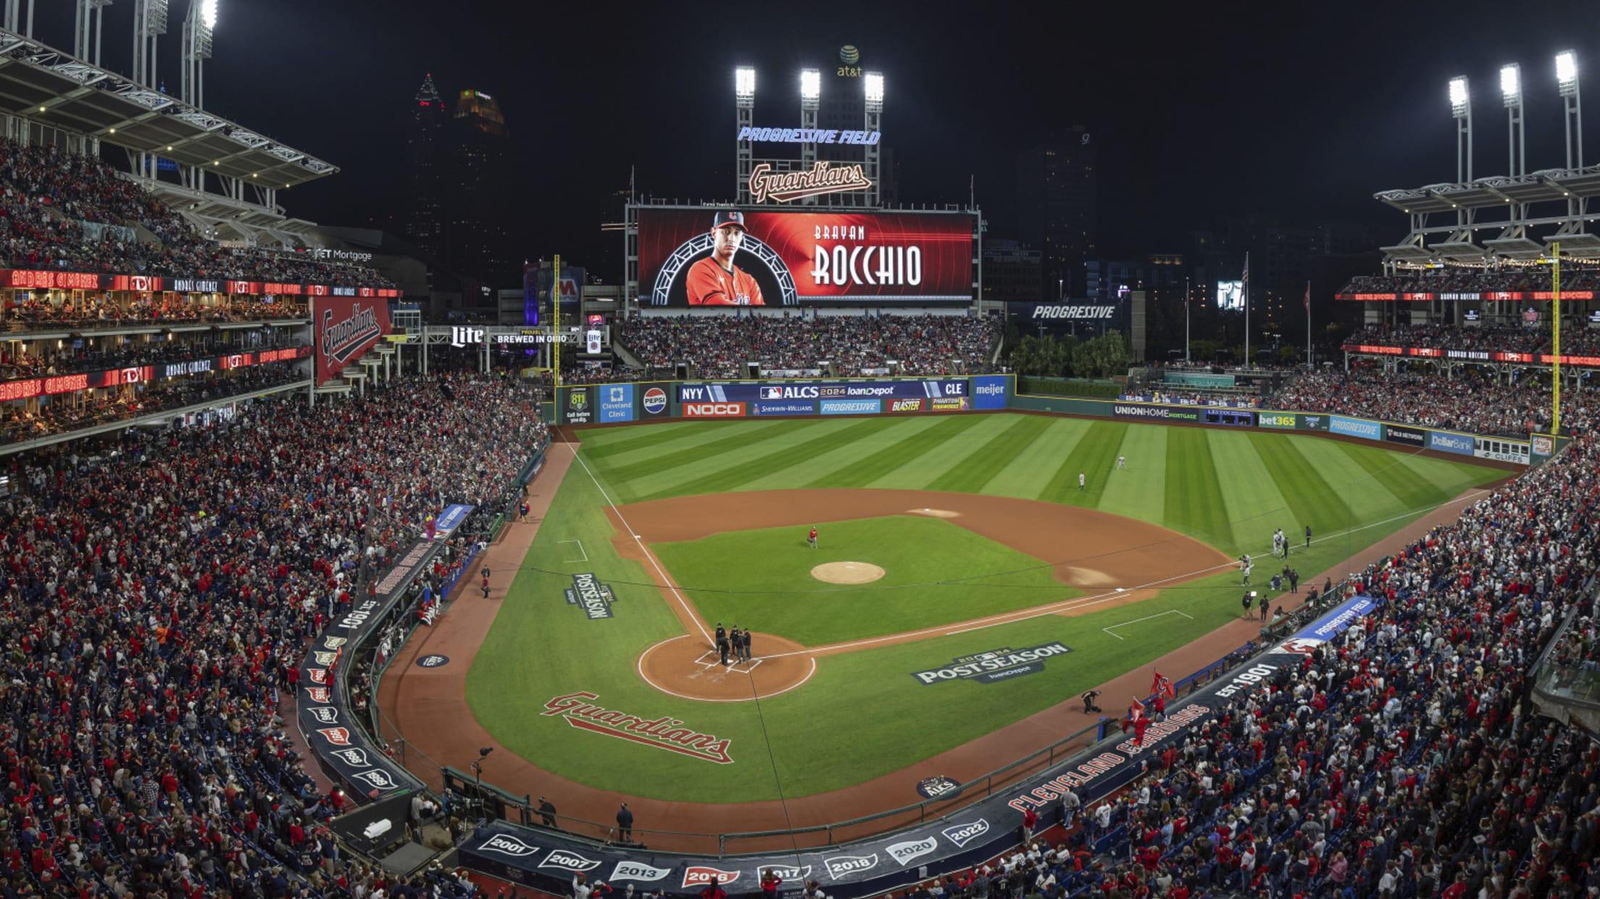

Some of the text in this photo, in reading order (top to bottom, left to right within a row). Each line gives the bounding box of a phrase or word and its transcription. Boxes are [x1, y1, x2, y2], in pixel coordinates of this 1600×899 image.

[837, 66, 862, 78] at&t
[738, 127, 881, 145] PROGRESSIVE FIELD
[749, 161, 872, 203] Guardians
[814, 225, 865, 240] BRAYAN
[333, 250, 372, 262] Mortgage
[810, 245, 922, 286] ROCCHIO
[1032, 305, 1115, 319] PROGRESSIVE
[323, 303, 380, 367] Guardians
[451, 326, 484, 348] Lite
[682, 388, 703, 400] NYY
[783, 386, 819, 398] ALCS
[847, 386, 894, 396] loanDepot
[945, 383, 962, 395] CLE
[976, 385, 1004, 396] meijer
[571, 393, 586, 405] 811
[644, 396, 666, 404] PEPSI
[892, 400, 920, 411] BLASTER
[687, 404, 740, 415] NOCO
[822, 402, 876, 411] PROGRESSIVE
[1259, 413, 1296, 426] bet365
[1331, 418, 1378, 436] PROGRESSIVE
[1495, 453, 1523, 464] CLIFFS
[575, 573, 608, 619] POSTSEASON
[917, 643, 1069, 684] POSTSEASON
[1236, 663, 1279, 686] 1901
[540, 691, 734, 764] Guardians
[1008, 752, 1125, 813] CLEVELAND
[950, 823, 986, 841] 2022
[490, 838, 526, 854] 2001
[894, 841, 932, 859] 2020
[549, 854, 589, 868] 2007
[832, 858, 872, 873] 2018
[619, 866, 657, 878] 2013
